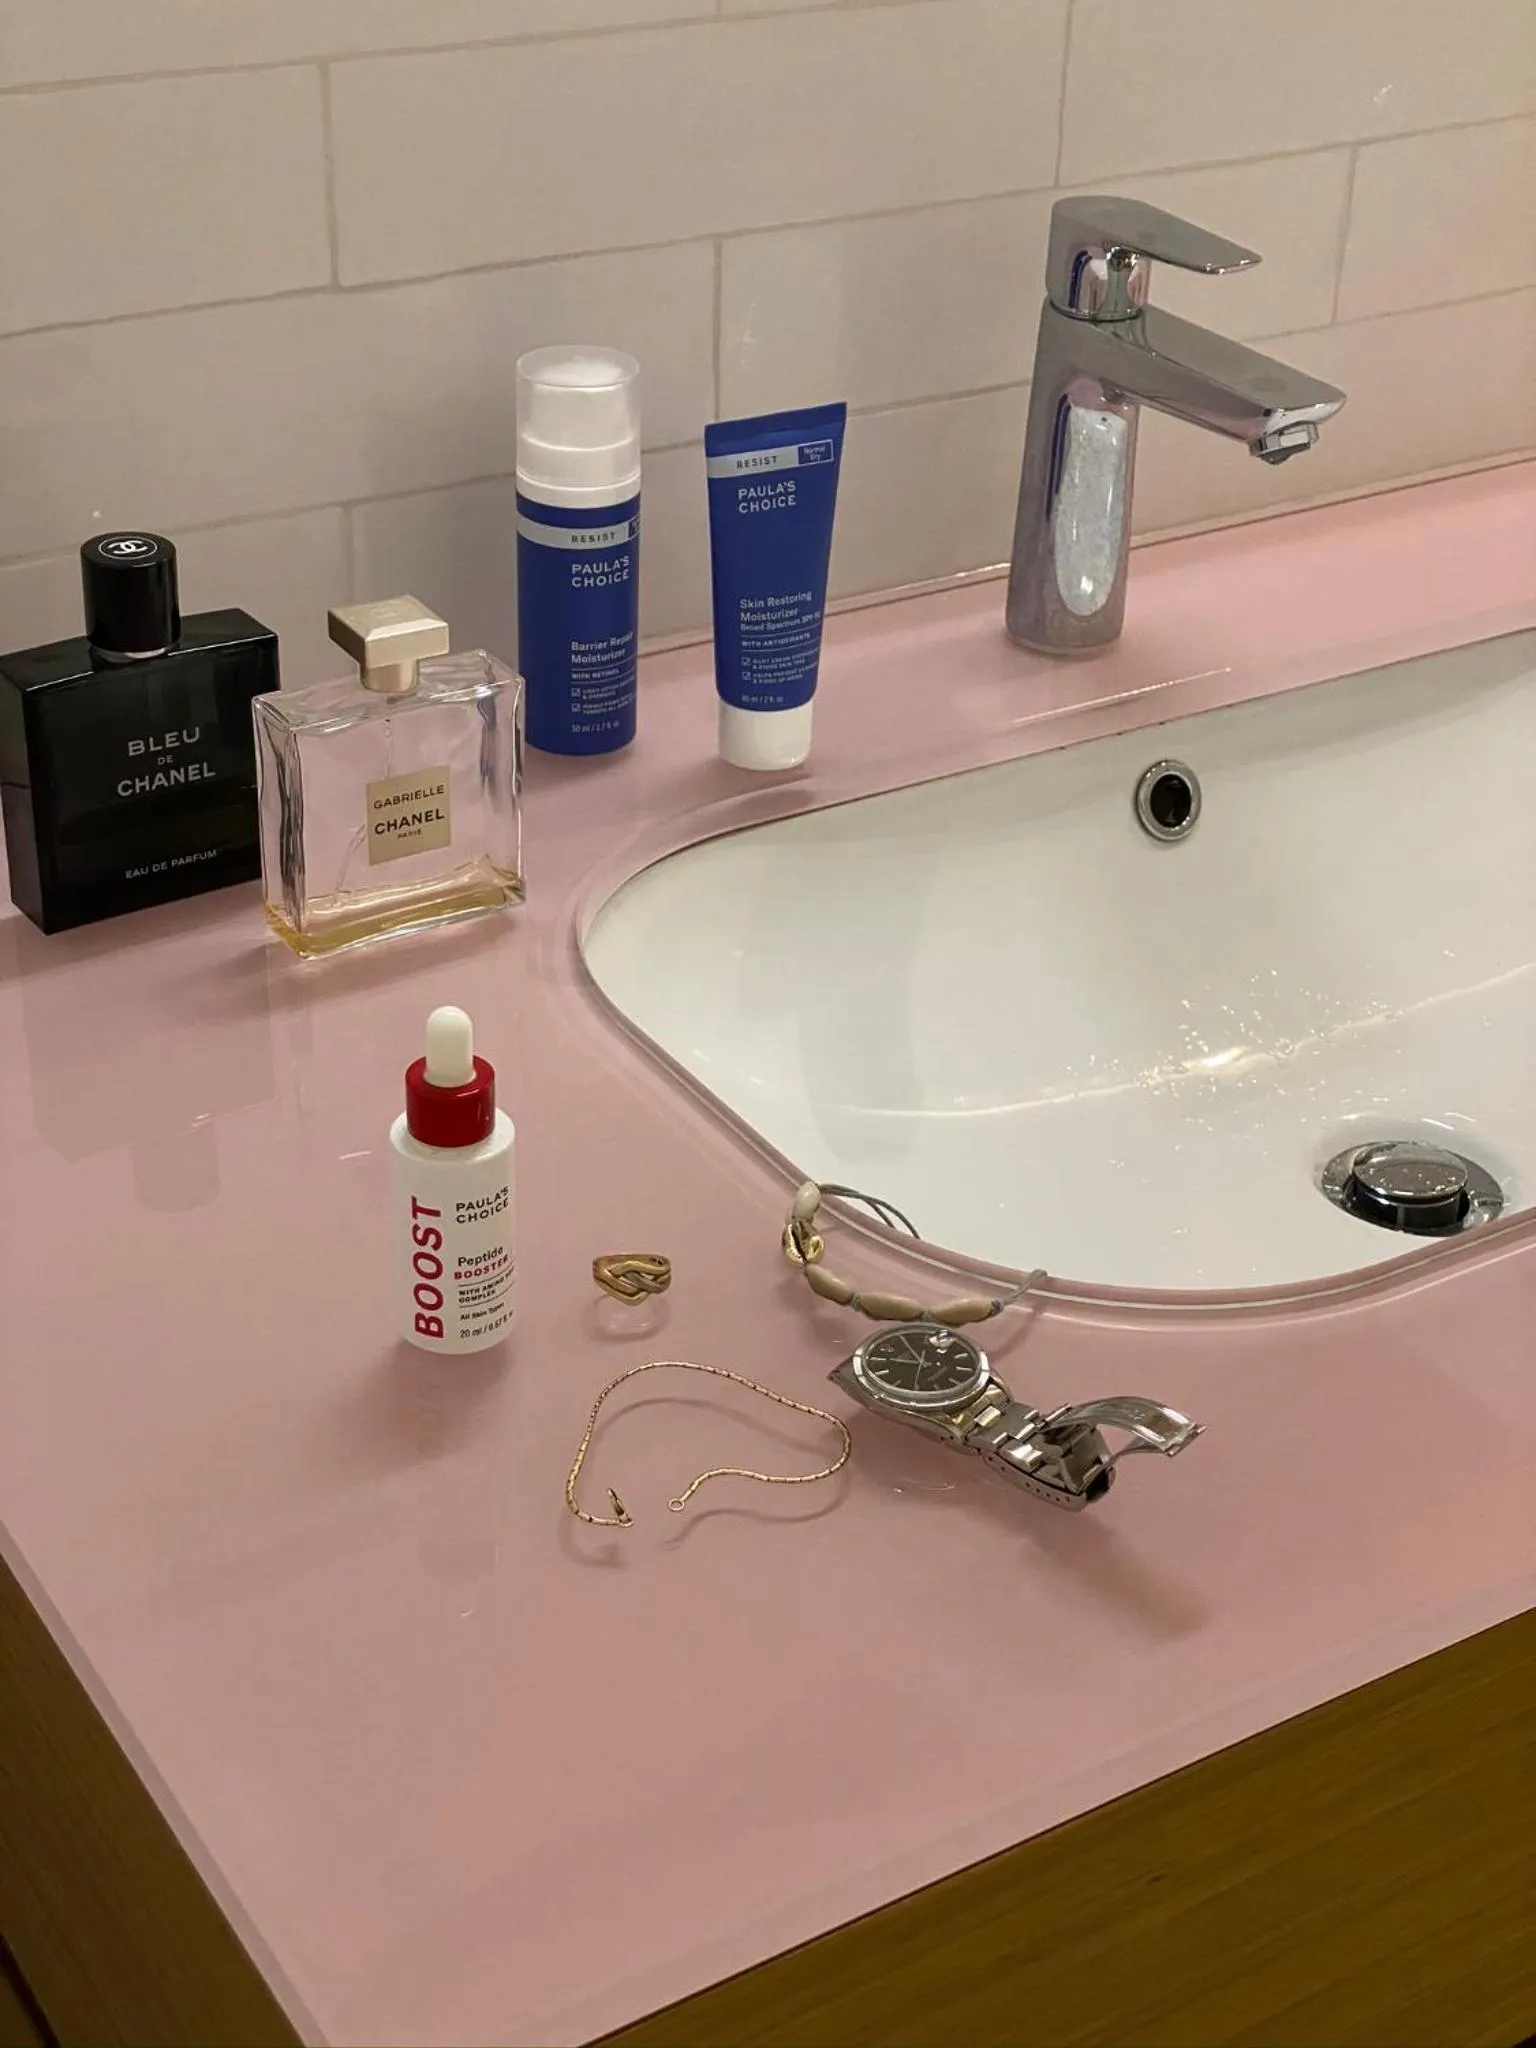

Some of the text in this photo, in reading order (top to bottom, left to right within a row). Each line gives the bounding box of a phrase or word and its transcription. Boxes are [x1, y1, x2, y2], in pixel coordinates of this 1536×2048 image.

[736, 455, 777, 468] RESIST
[738, 480, 796, 500] PAULA'S
[738, 495, 797, 514] CHOICE
[571, 531, 616, 543] RESIST
[571, 555, 630, 575] PAULA'S
[571, 568, 630, 588] CHOICE
[740, 591, 812, 609] Skin Restoring
[740, 608, 798, 621] Moisturizer
[571, 640, 609, 651] Barrier
[571, 648, 626, 664] Moisturizer
[128, 726, 200, 757] BLEU
[157, 754, 174, 765] DE
[117, 761, 216, 796] CHANEL
[373, 784, 445, 809] GABRIELLE
[374, 808, 445, 835] CHANEL
[125, 849, 217, 879] EAU DE PARFUM
[456, 1186, 509, 1212] PAULA'S
[456, 1197, 509, 1224] CHOICE
[458, 1246, 503, 1266] Peptide
[411, 1195, 444, 1339] BOOST
[454, 1254, 509, 1280] BOOSTER
[458, 1289, 496, 1304] COMPLEX
[459, 1288, 480, 1296] WITH
[460, 1329, 470, 1339] 20
